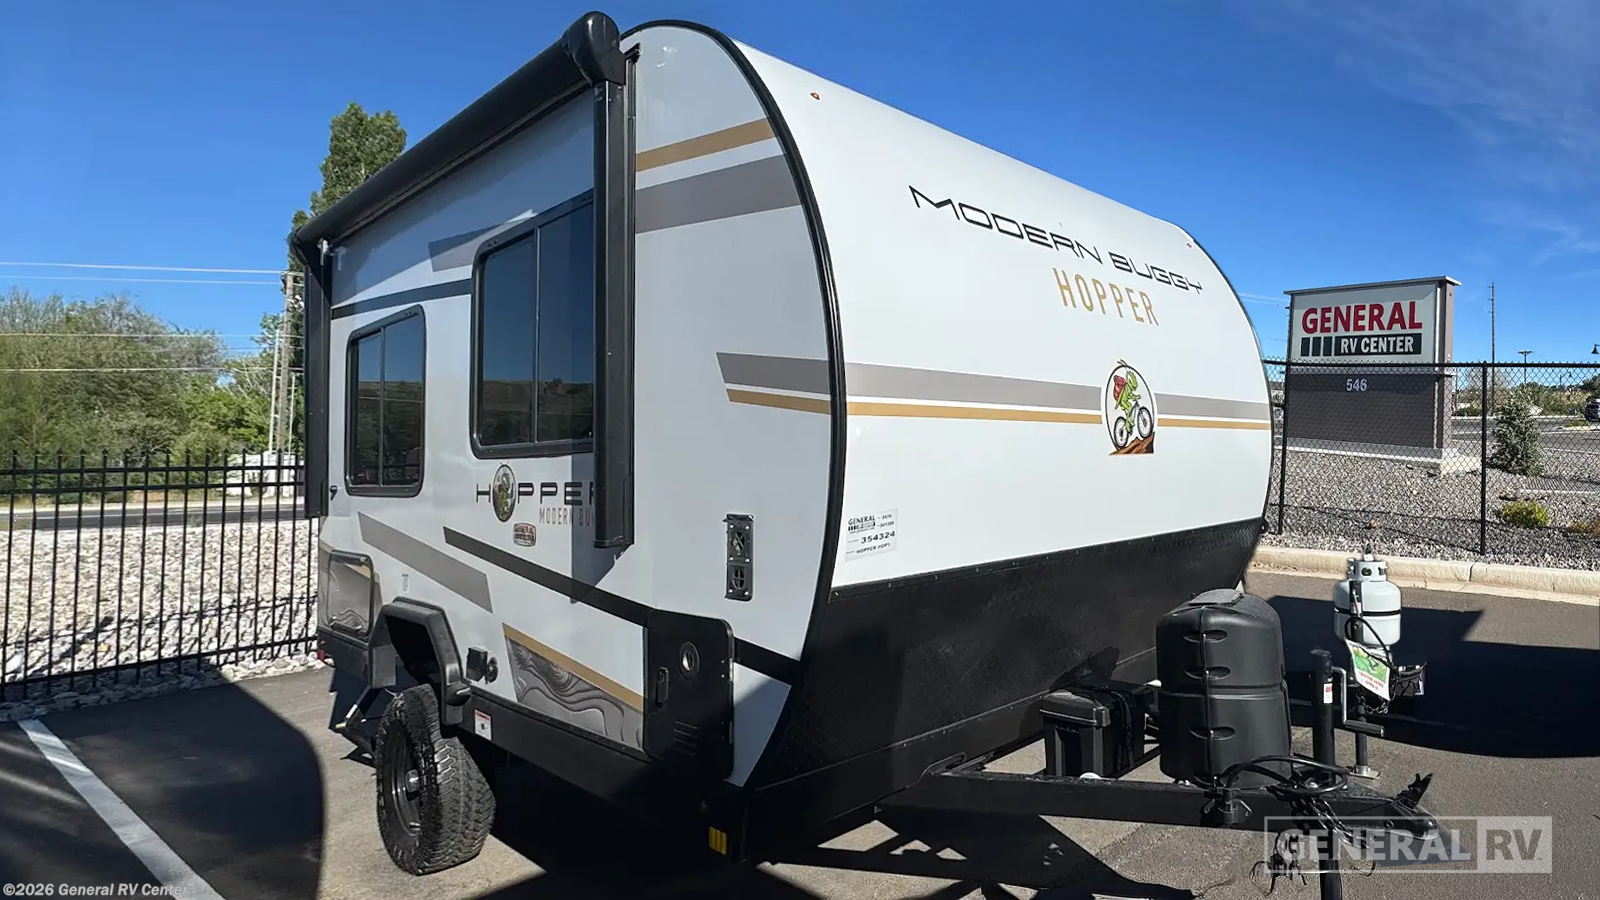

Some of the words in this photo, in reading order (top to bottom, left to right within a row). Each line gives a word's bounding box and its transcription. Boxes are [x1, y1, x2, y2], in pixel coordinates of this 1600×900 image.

[908, 185, 1103, 264] MODERN
[1108, 251, 1203, 294] BUGGY
[1052, 267, 1159, 326] HOPPER
[1302, 301, 1423, 334] GENERAL
[1340, 337, 1358, 353] RV
[1361, 336, 1414, 353] CENTER
[1345, 378, 1368, 392] 546
[539, 507, 574, 526] MODERN
[848, 515, 875, 525] GENERAL
[861, 531, 895, 544] 354324
